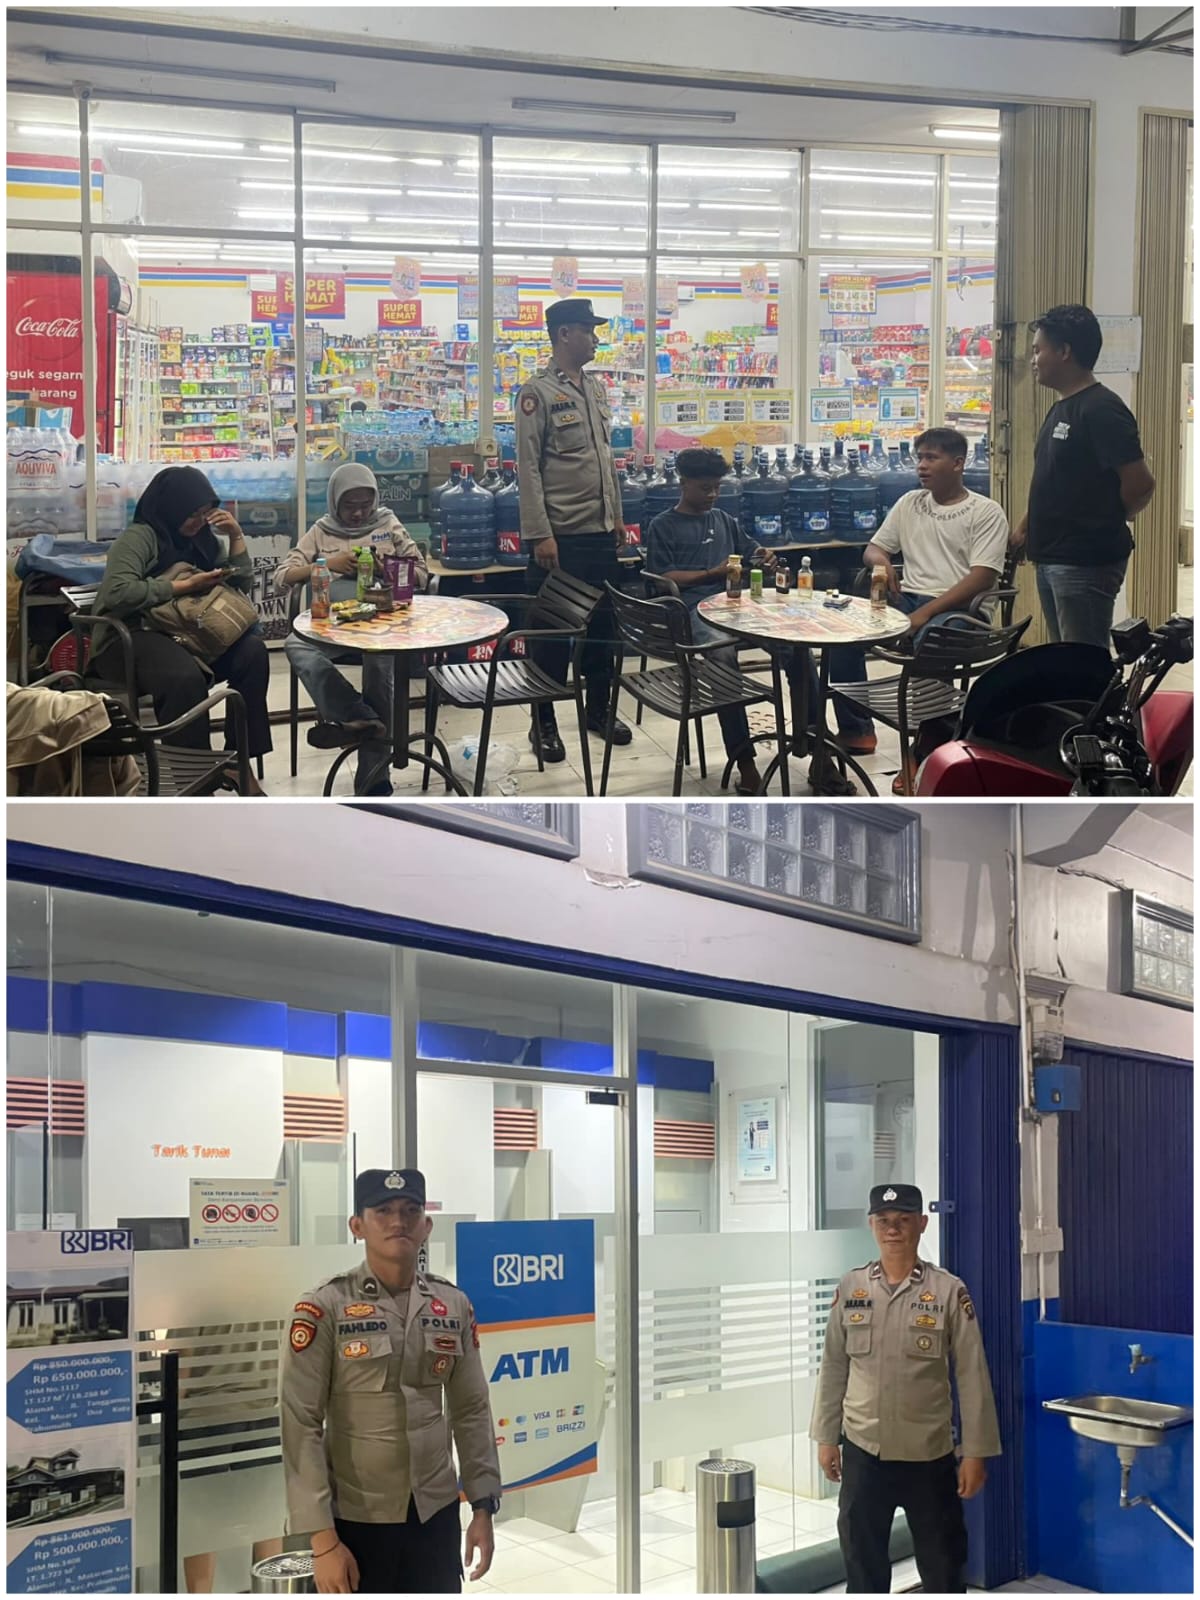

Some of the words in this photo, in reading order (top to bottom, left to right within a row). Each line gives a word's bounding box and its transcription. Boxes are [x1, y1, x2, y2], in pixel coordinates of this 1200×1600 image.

[284, 279, 336, 291] SPER
[284, 291, 336, 303] HMAT
[383, 303, 417, 312] SUPER
[519, 304, 538, 313] PER
[383, 312, 417, 320] HEMAT
[519, 313, 538, 321] MAT
[16, 317, 81, 338] Coca-Cola
[253, 556, 281, 568] EST
[152, 1143, 188, 1158] Tarik
[91, 1231, 132, 1251] BRI
[522, 1253, 564, 1283] BRI
[911, 1302, 944, 1313] POLRI
[338, 1320, 388, 1336] FAHLEDO
[421, 1318, 461, 1330] POLRI
[489, 1346, 569, 1383] ATM
[33, 1375, 49, 1384] Rp
[534, 1411, 550, 1421] VISA
[556, 1421, 586, 1433] BRIZZI
[34, 1551, 50, 1561] Rp
